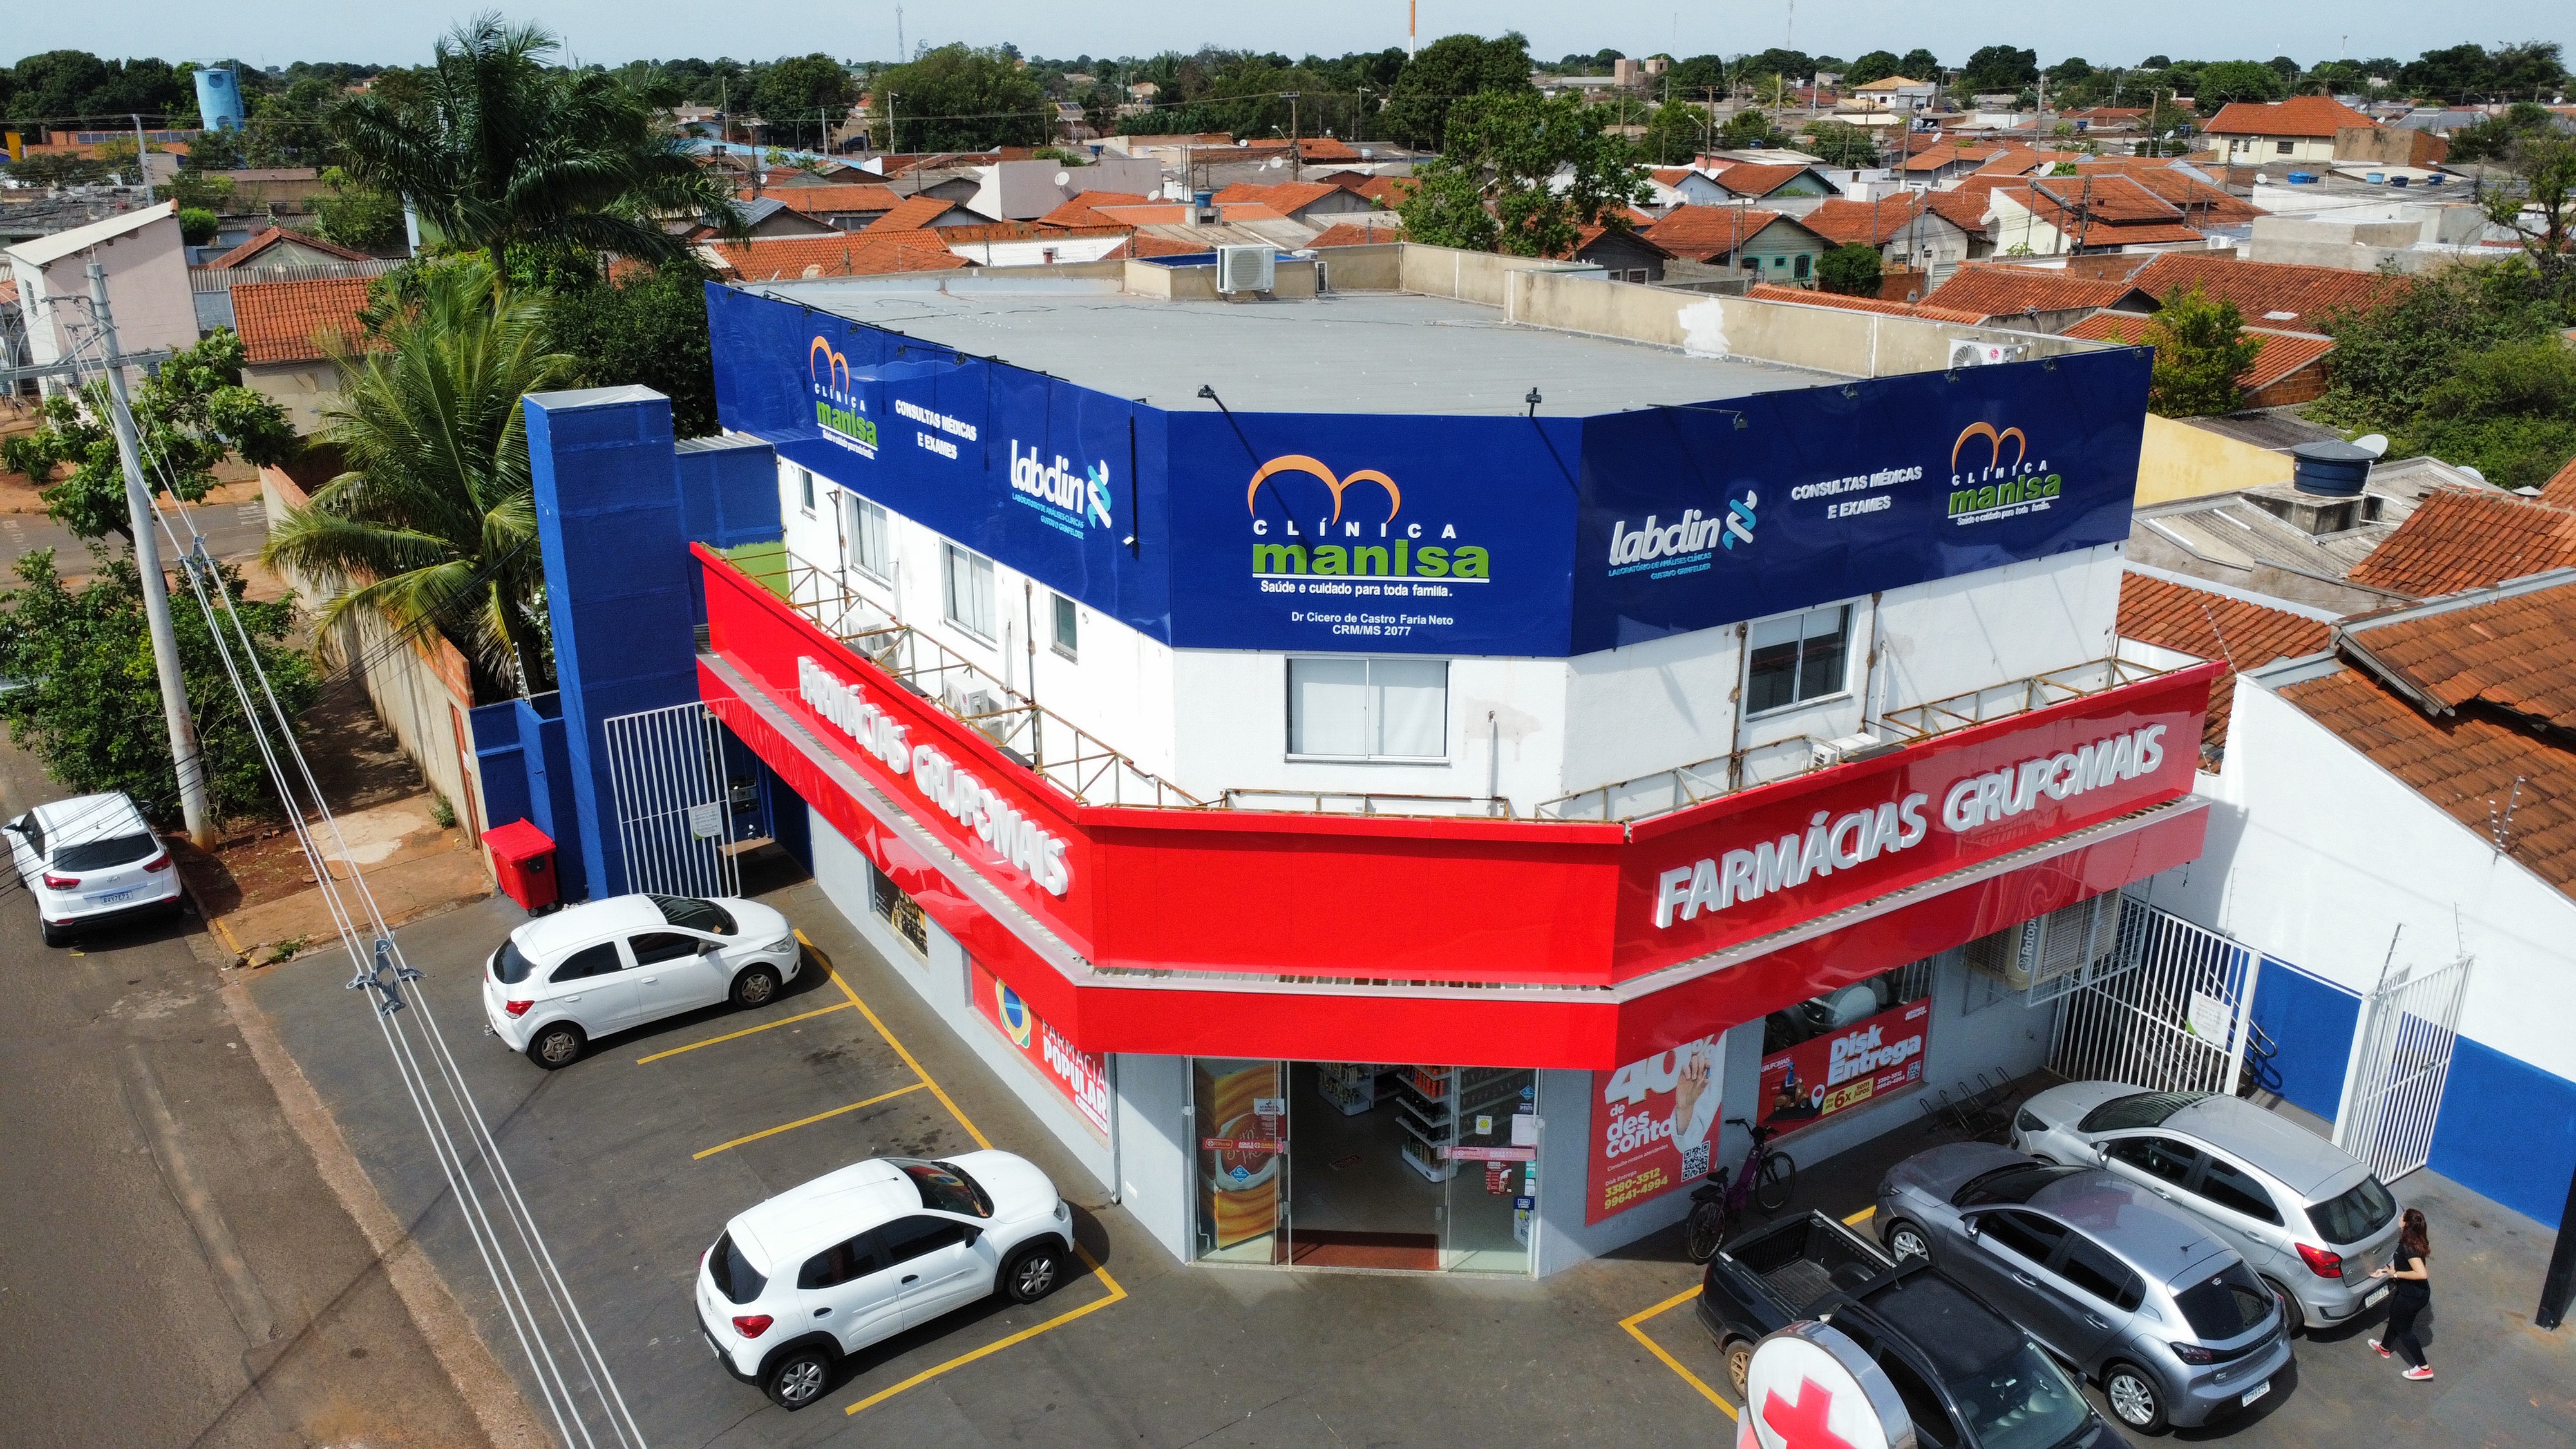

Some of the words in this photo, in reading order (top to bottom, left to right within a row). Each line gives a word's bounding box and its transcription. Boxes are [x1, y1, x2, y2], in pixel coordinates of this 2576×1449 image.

[815, 383, 866, 412] CLÍNICA
[816, 400, 878, 446] manisa
[895, 399, 940, 428] CONSULTAS
[942, 414, 977, 441] MÉDICAS
[917, 431, 923, 447] E
[924, 434, 958, 460] EXAMES
[1010, 439, 1084, 515] labclin
[1792, 475, 1868, 500] CONSULTAS
[1870, 466, 1922, 488] MÉDICAS
[1952, 460, 2047, 486] CLÍNICA
[1828, 504, 1837, 519] E
[1840, 495, 1891, 517] EXAMES
[1949, 474, 2061, 515] manisa
[1253, 518, 1456, 538] CLÍNICA
[1609, 509, 1721, 566] labclin
[1253, 539, 1489, 578] manisa
[1609, 562, 1651, 576] LABORATÓRIO
[1660, 556, 1687, 567] ANÁLISES
[1687, 552, 1712, 563] CLÍNICAS
[1261, 580, 1296, 593] Saúde
[1299, 584, 1306, 593] e
[1309, 582, 1352, 595] cuidado
[1355, 585, 1380, 598] para
[1384, 584, 1408, 596] toda
[1651, 570, 1676, 580] GUSTAVO
[1291, 611, 1304, 622] Dr
[1307, 611, 1341, 623] Cícero
[1344, 613, 1357, 623] de
[1360, 613, 1396, 625] Castro
[1400, 614, 1426, 625] Faria
[1428, 614, 1454, 626] Neto
[1332, 624, 1381, 636] CRM/MS
[1384, 625, 1411, 636] 2077
[797, 656, 910, 774] FARMÁCIAS
[1655, 793, 1927, 929] FARMÁCIAS
[1830, 1024, 1884, 1064] Disk
[1827, 1035, 1922, 1086] Entrega
[1043, 1035, 1106, 1120] POPULAR
[1853, 1088, 1870, 1098] juros
[1834, 1090, 1852, 1108] 6x
[1857, 1081, 1870, 1090] sem
[1610, 1104, 1625, 1117] de
[1605, 1119, 1672, 1158] conto
[1607, 1111, 1650, 1142] des
[1604, 1175, 1668, 1210] 99641-4994
[1605, 1178, 1616, 1186] Disk
[1618, 1170, 1637, 1182] Entrega
[1605, 1167, 1660, 1198] 3380-3512
